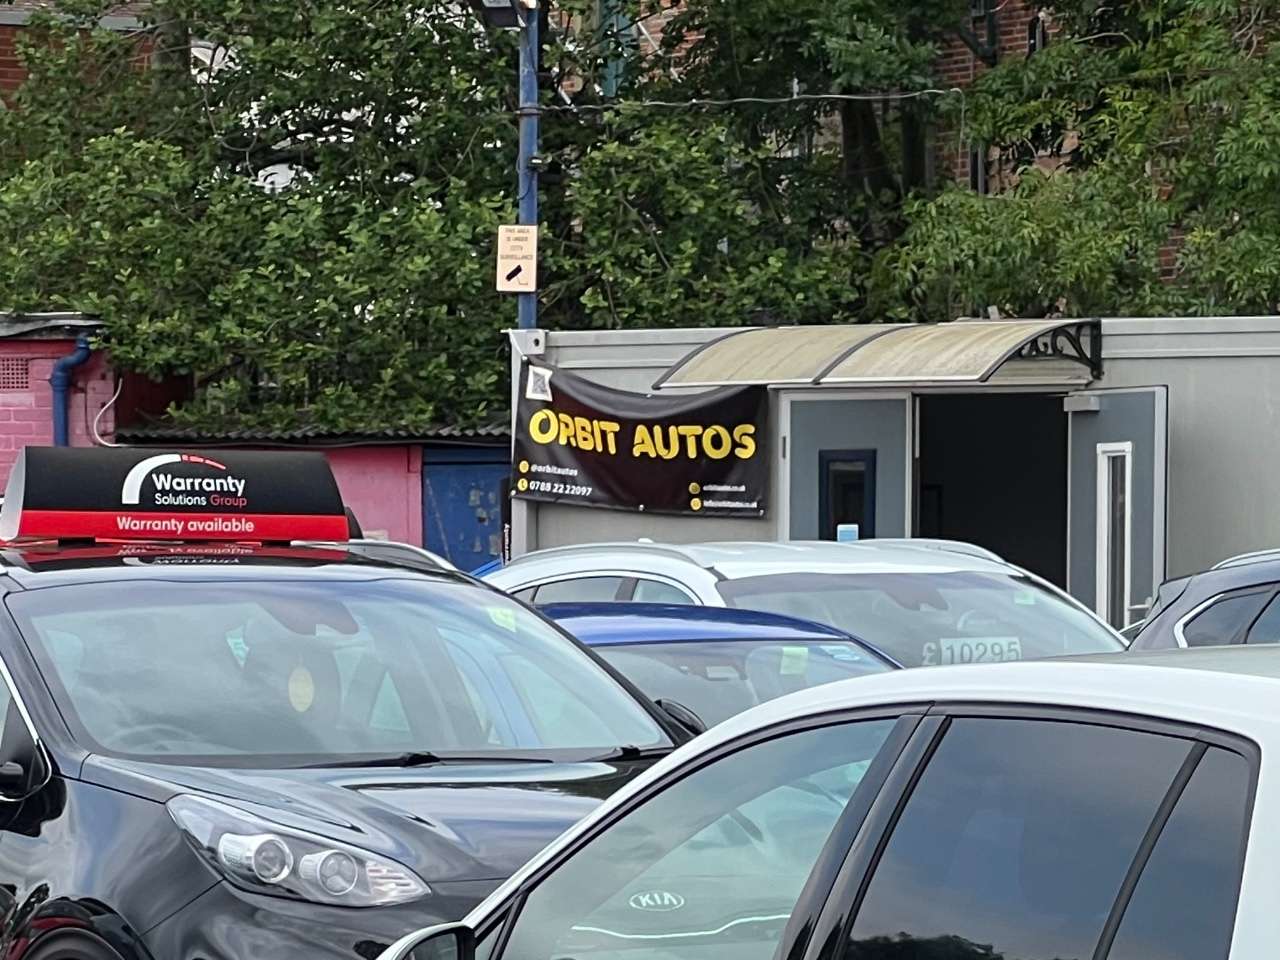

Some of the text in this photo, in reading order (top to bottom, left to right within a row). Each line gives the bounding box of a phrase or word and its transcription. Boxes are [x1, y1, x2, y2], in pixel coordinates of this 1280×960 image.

[529, 408, 756, 459] ORBIT AUTOS
[151, 473, 246, 497] Warranty
[154, 493, 248, 507] Solutions Group
[116, 516, 255, 534] Warranty available
[638, 892, 677, 907] KIA
